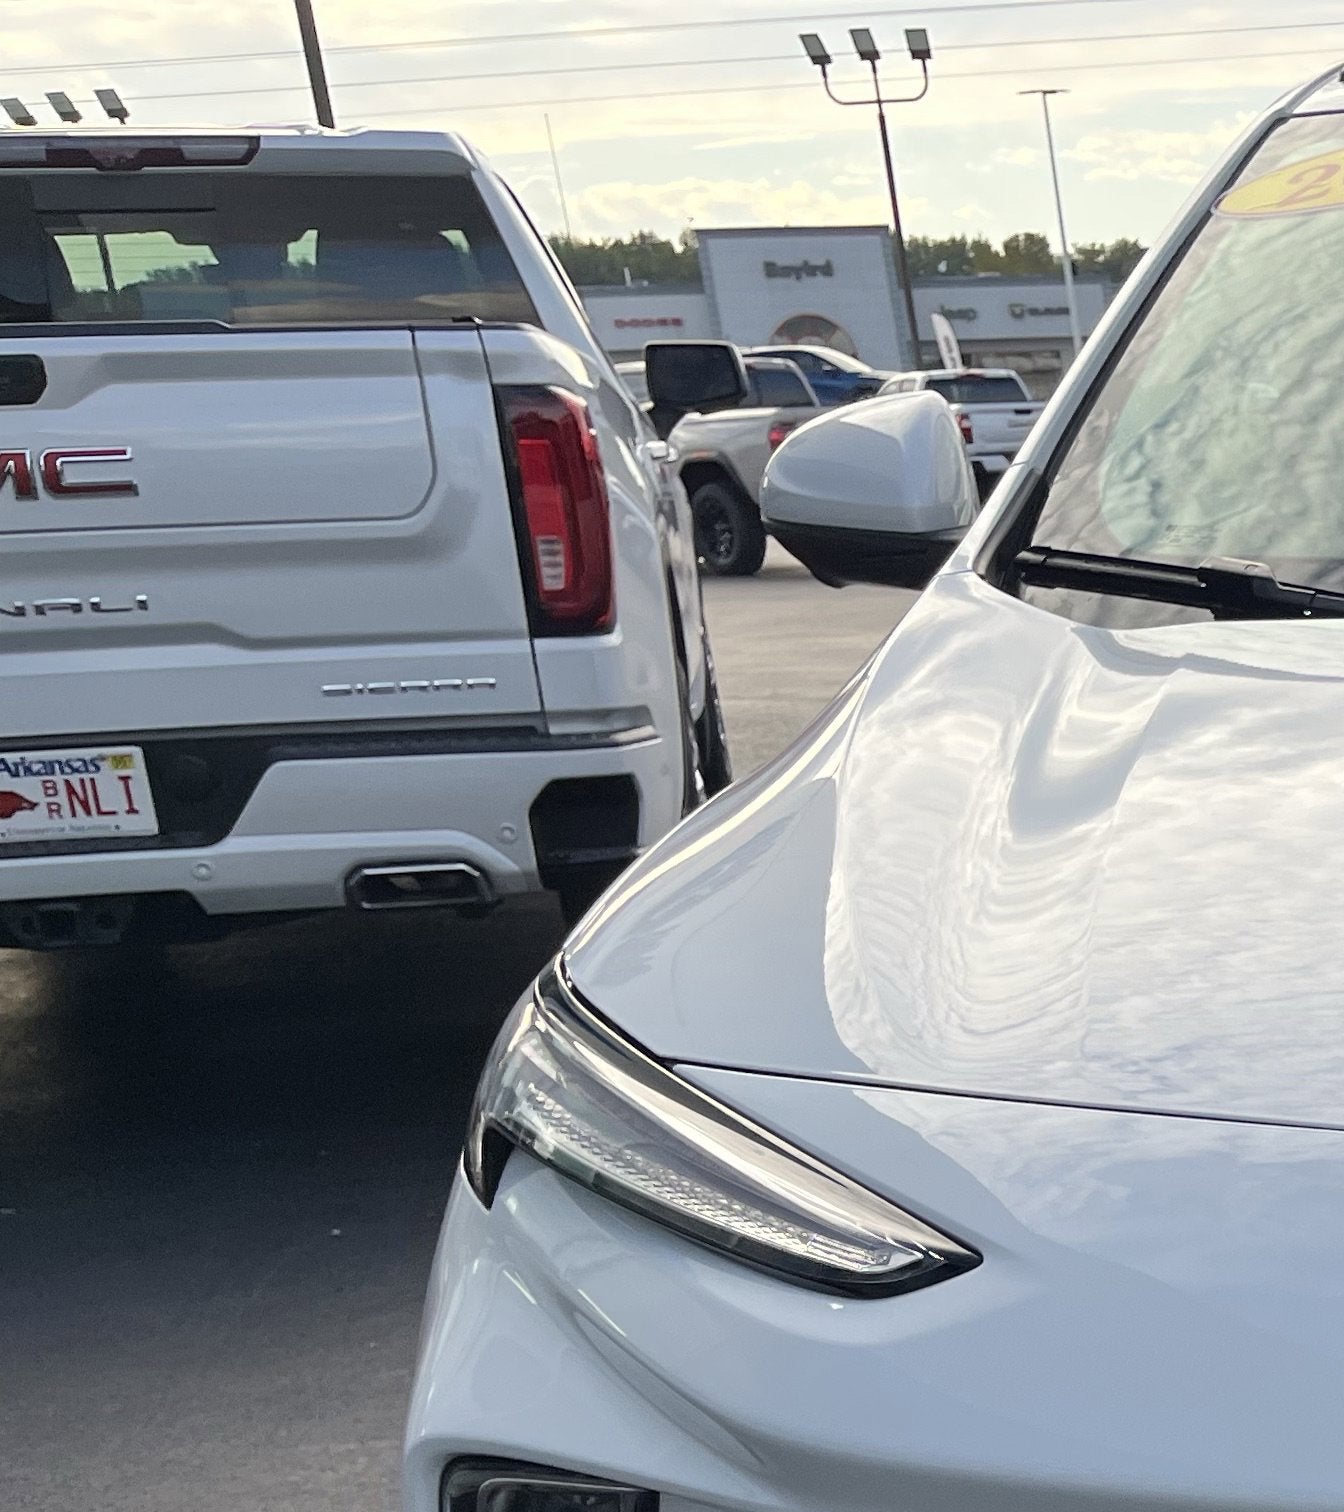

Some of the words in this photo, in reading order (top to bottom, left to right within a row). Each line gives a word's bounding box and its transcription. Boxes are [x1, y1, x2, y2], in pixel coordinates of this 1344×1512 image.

[614, 317, 684, 329] DODGE
[321, 677, 497, 697] SIERRA
[63, 775, 140, 818] NLI
